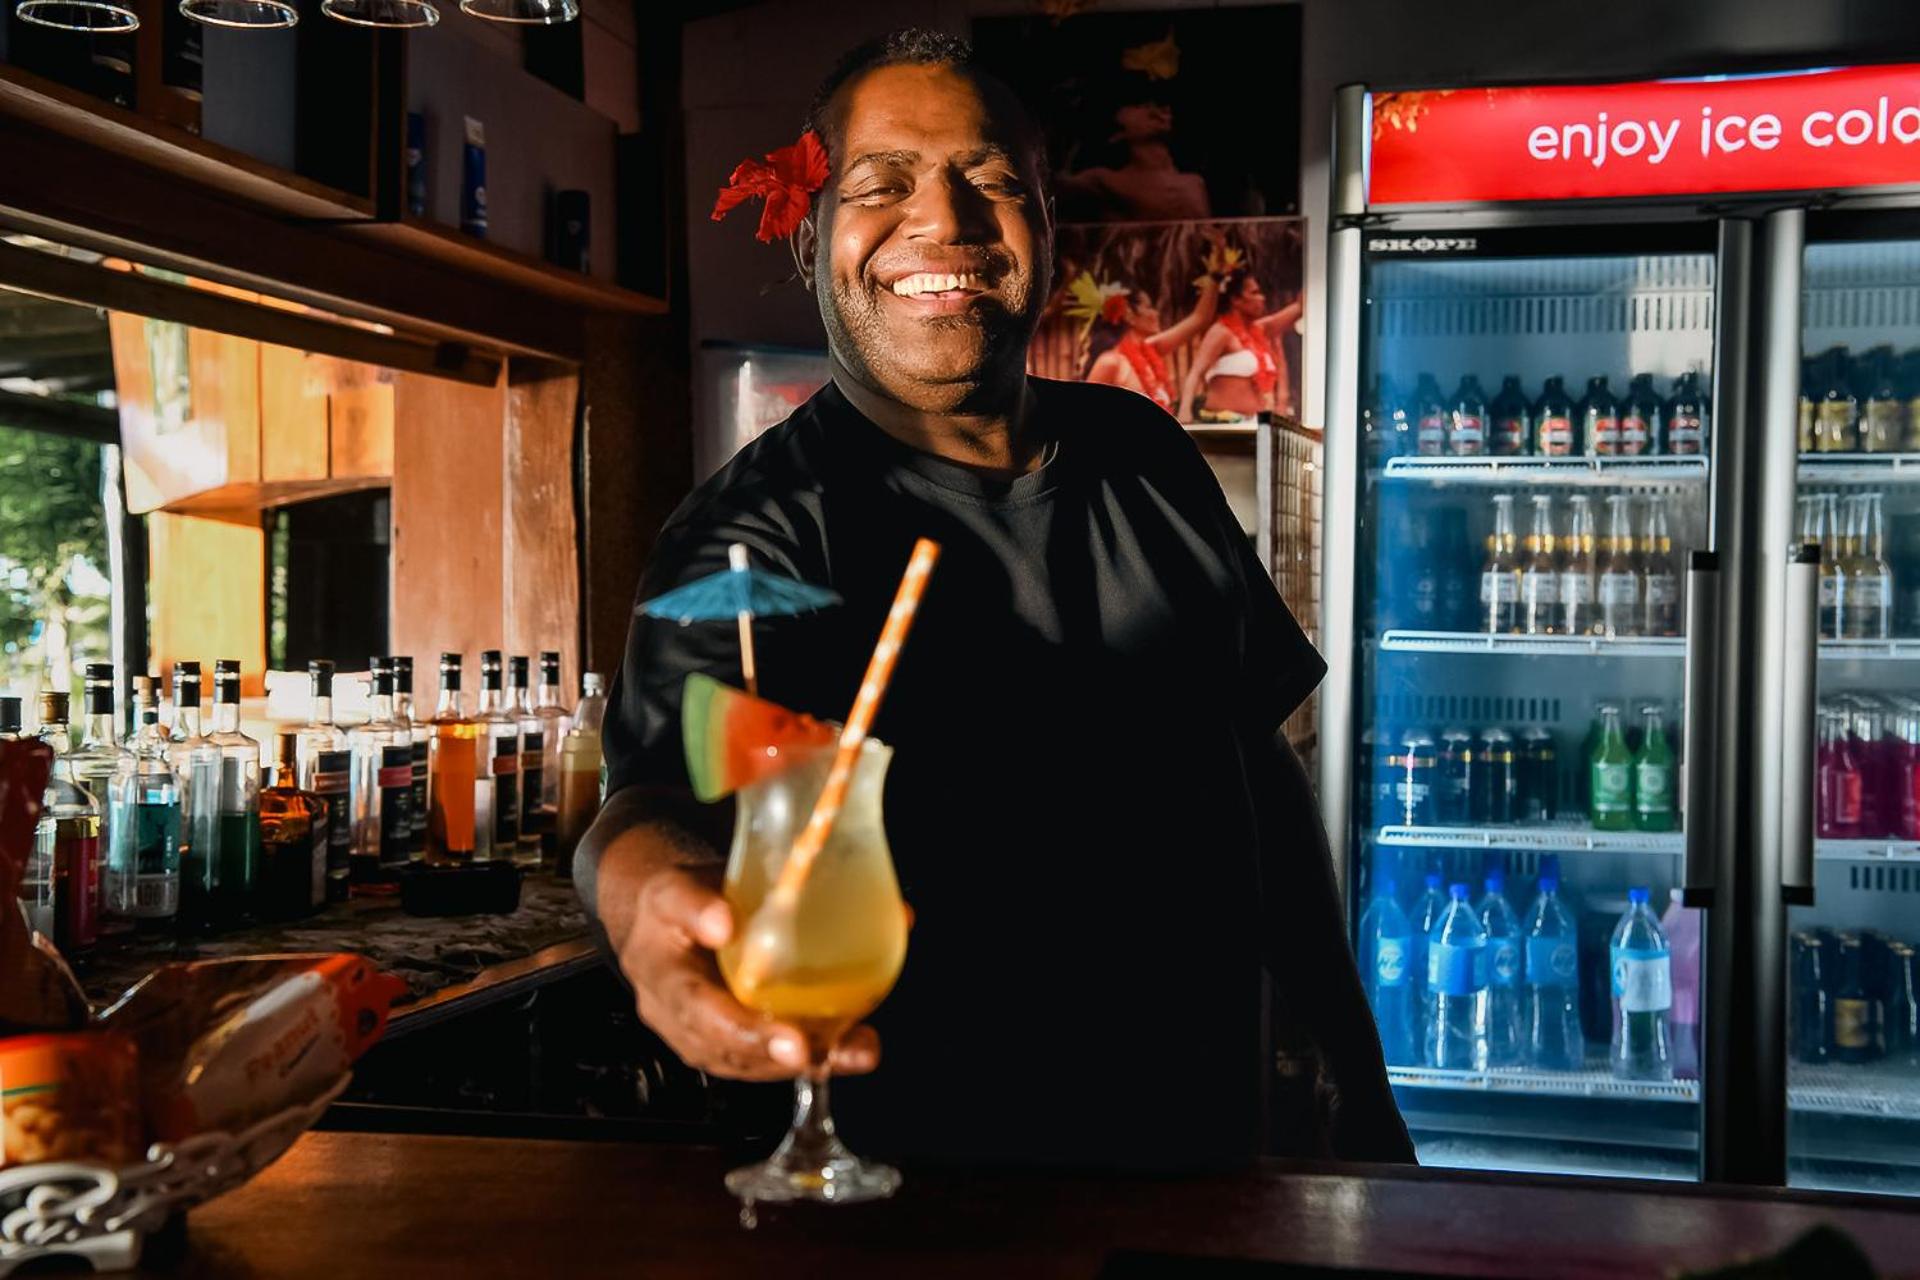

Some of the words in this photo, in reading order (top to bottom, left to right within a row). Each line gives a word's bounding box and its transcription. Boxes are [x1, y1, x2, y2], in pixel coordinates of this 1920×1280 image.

[1527, 112, 1681, 168] enjoy
[1700, 106, 1782, 157] ice
[1369, 237, 1477, 252] SKOPE
